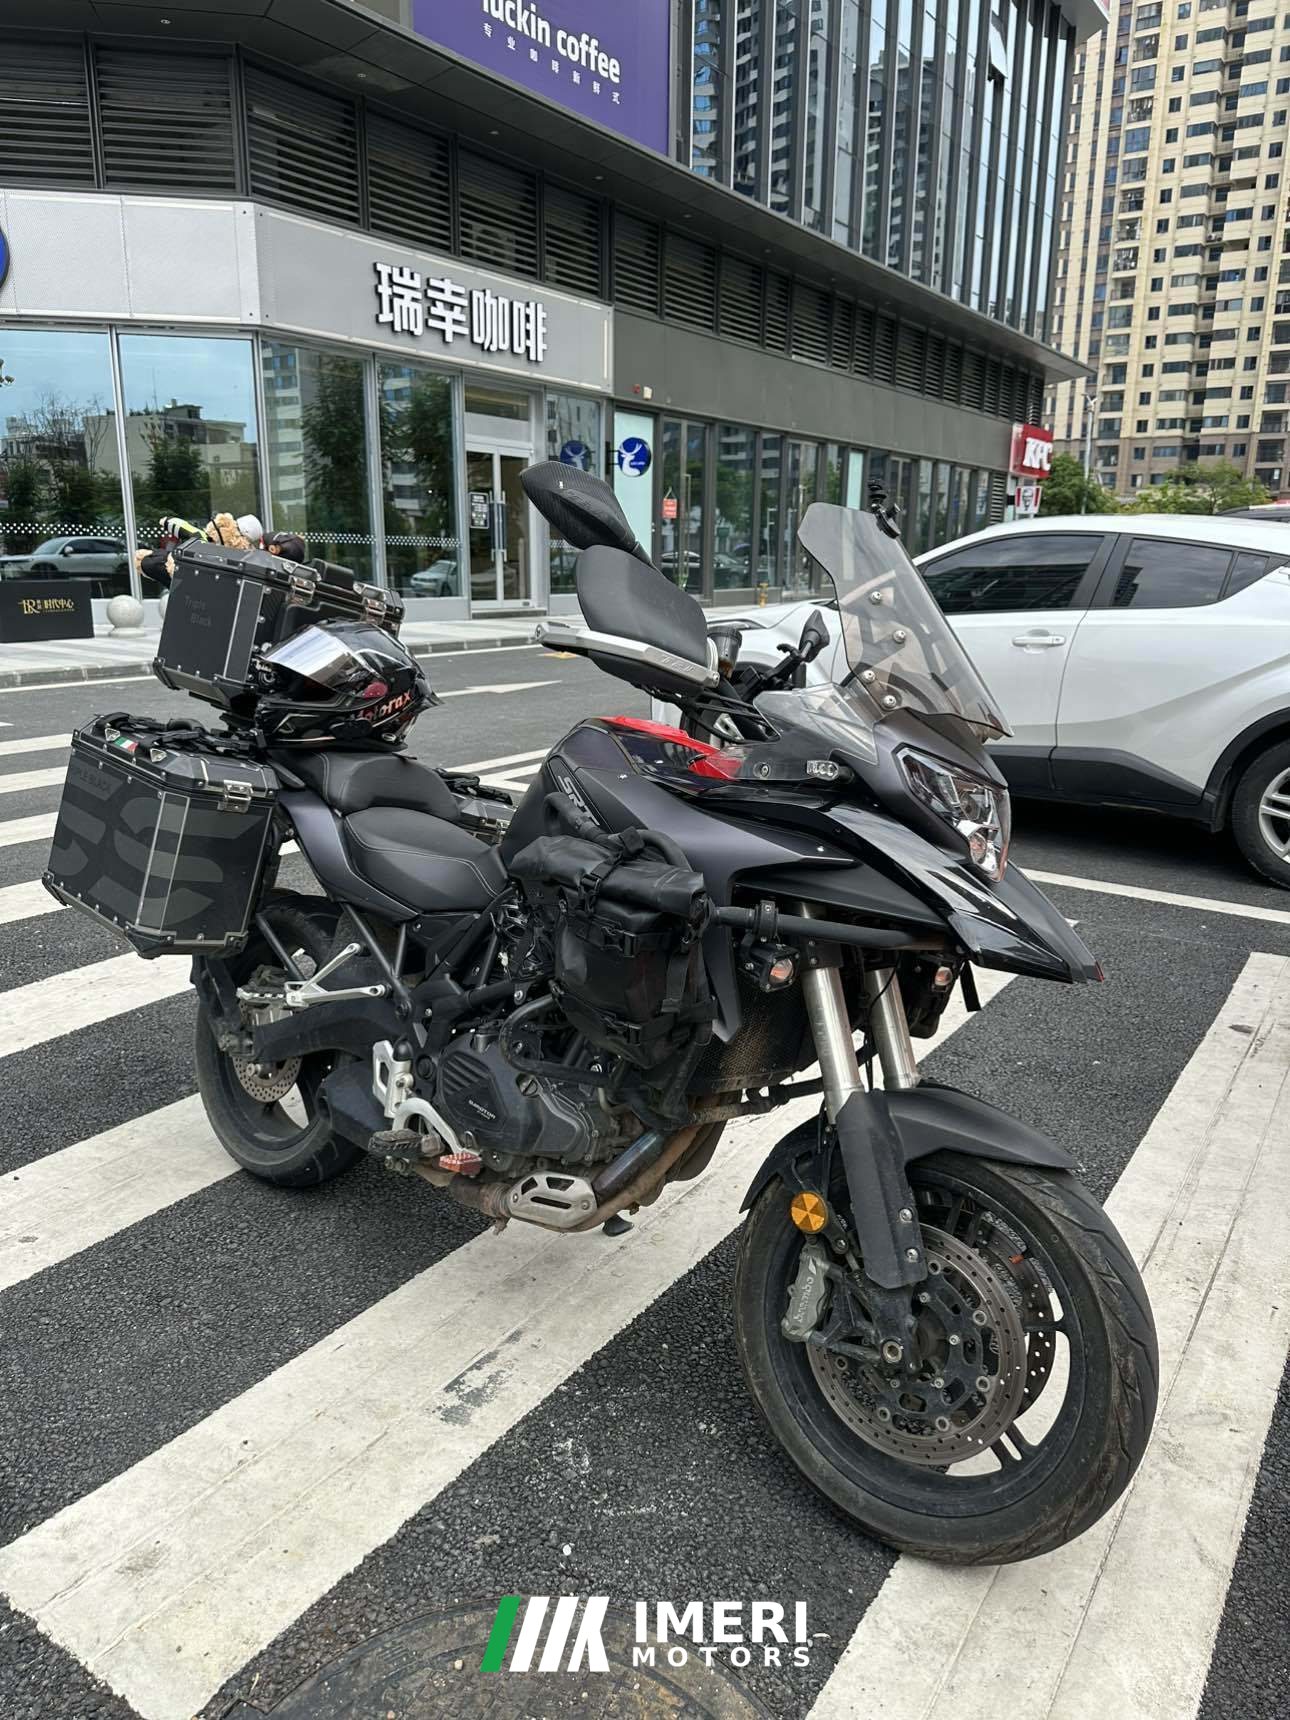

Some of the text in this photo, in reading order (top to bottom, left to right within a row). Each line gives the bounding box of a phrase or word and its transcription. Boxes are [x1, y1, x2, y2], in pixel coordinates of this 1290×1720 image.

[556, 29, 620, 84] coffee
[373, 261, 548, 363] 瑞幸咖啡
[1022, 437, 1053, 471] KFC
